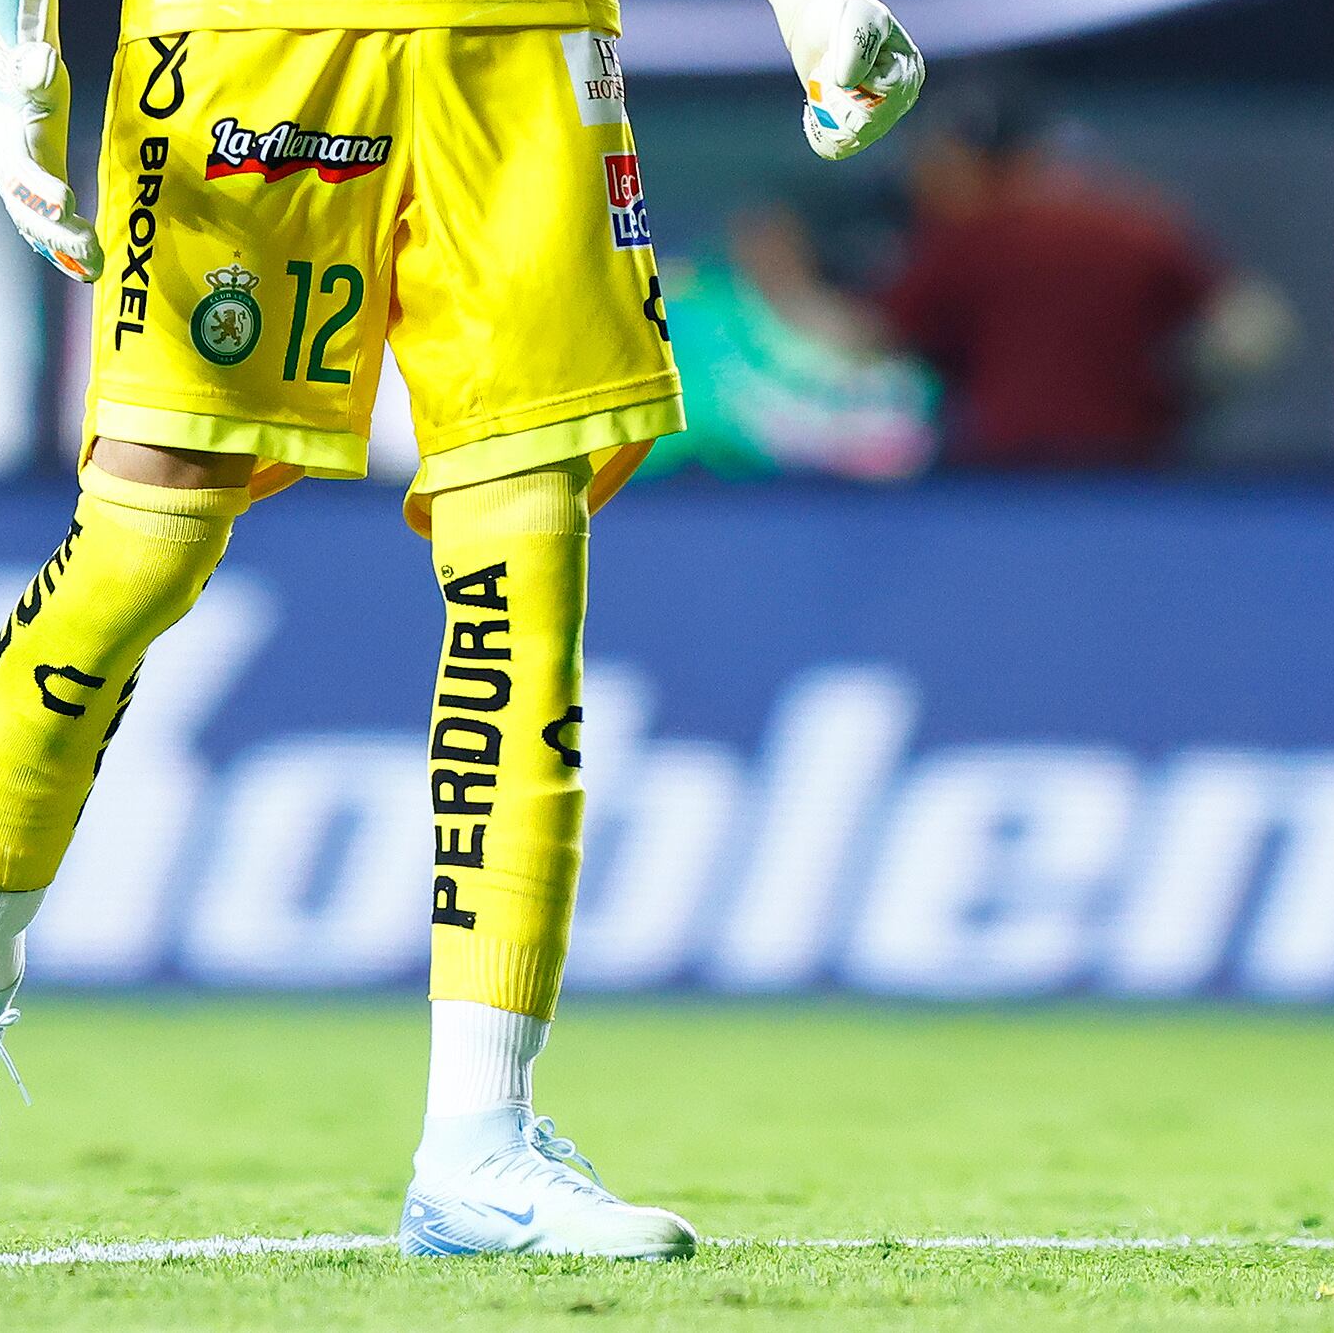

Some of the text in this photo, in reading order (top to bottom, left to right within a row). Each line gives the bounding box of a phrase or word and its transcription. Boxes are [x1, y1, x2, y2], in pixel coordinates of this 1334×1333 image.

[214, 120, 388, 165] La Alemana
[115, 136, 169, 351] BROXEL
[283, 260, 365, 385] 12
[431, 561, 513, 931] PERDURA
